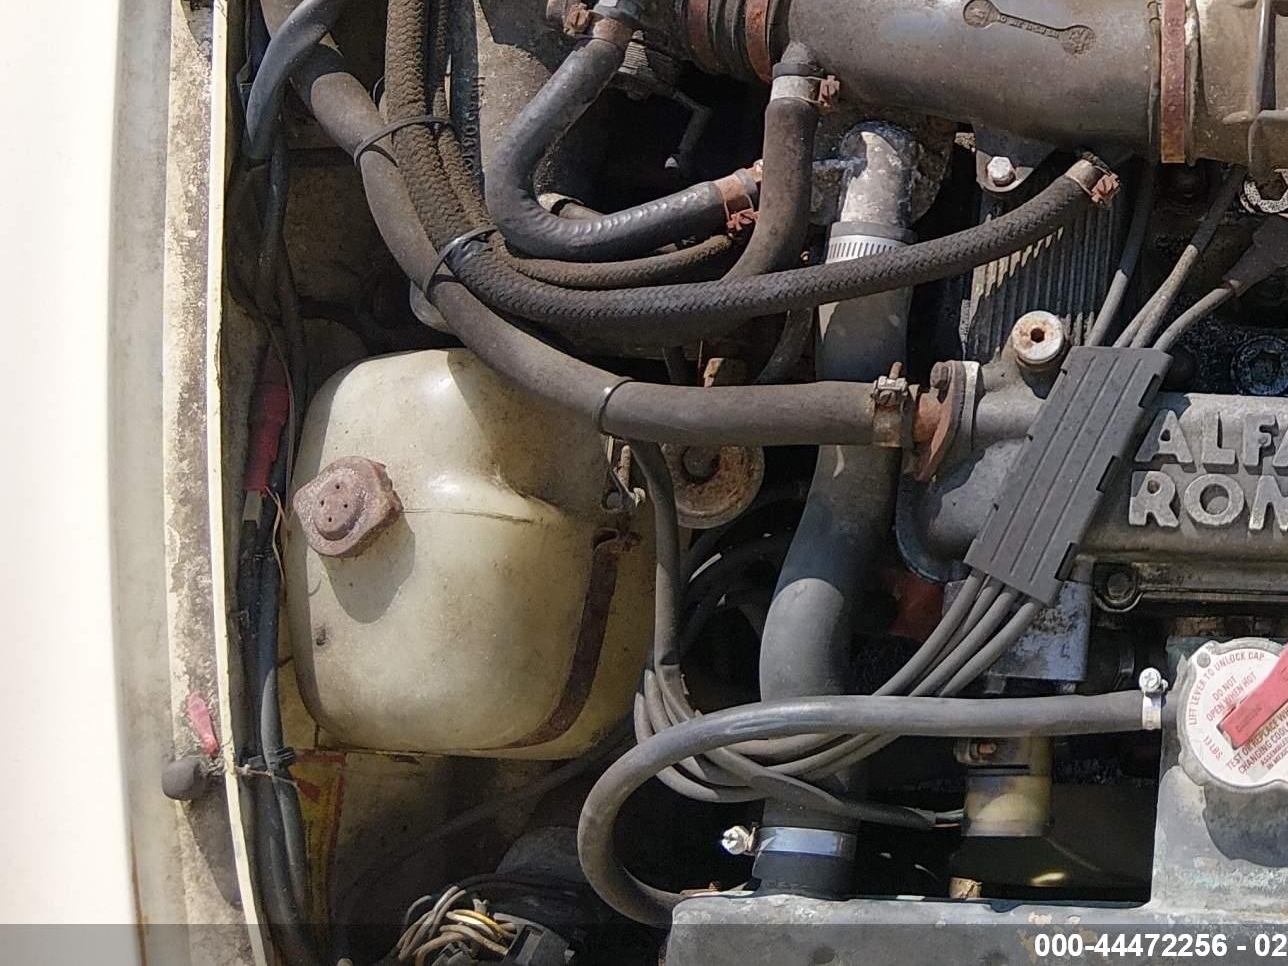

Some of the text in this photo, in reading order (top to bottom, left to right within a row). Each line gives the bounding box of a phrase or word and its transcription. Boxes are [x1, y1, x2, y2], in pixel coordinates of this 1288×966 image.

[1189, 651, 1265, 725] LIFT LEVER TO UNLOCK CAP
[1206, 702, 1225, 722] OPEN
[1223, 685, 1244, 706] WHEN
[1243, 671, 1257, 688] HOT
[1212, 675, 1238, 701] DO NOT
[1226, 752, 1244, 770] TEST
[1251, 720, 1279, 748] REPLACE
[1238, 740, 1273, 774] CHANGING
